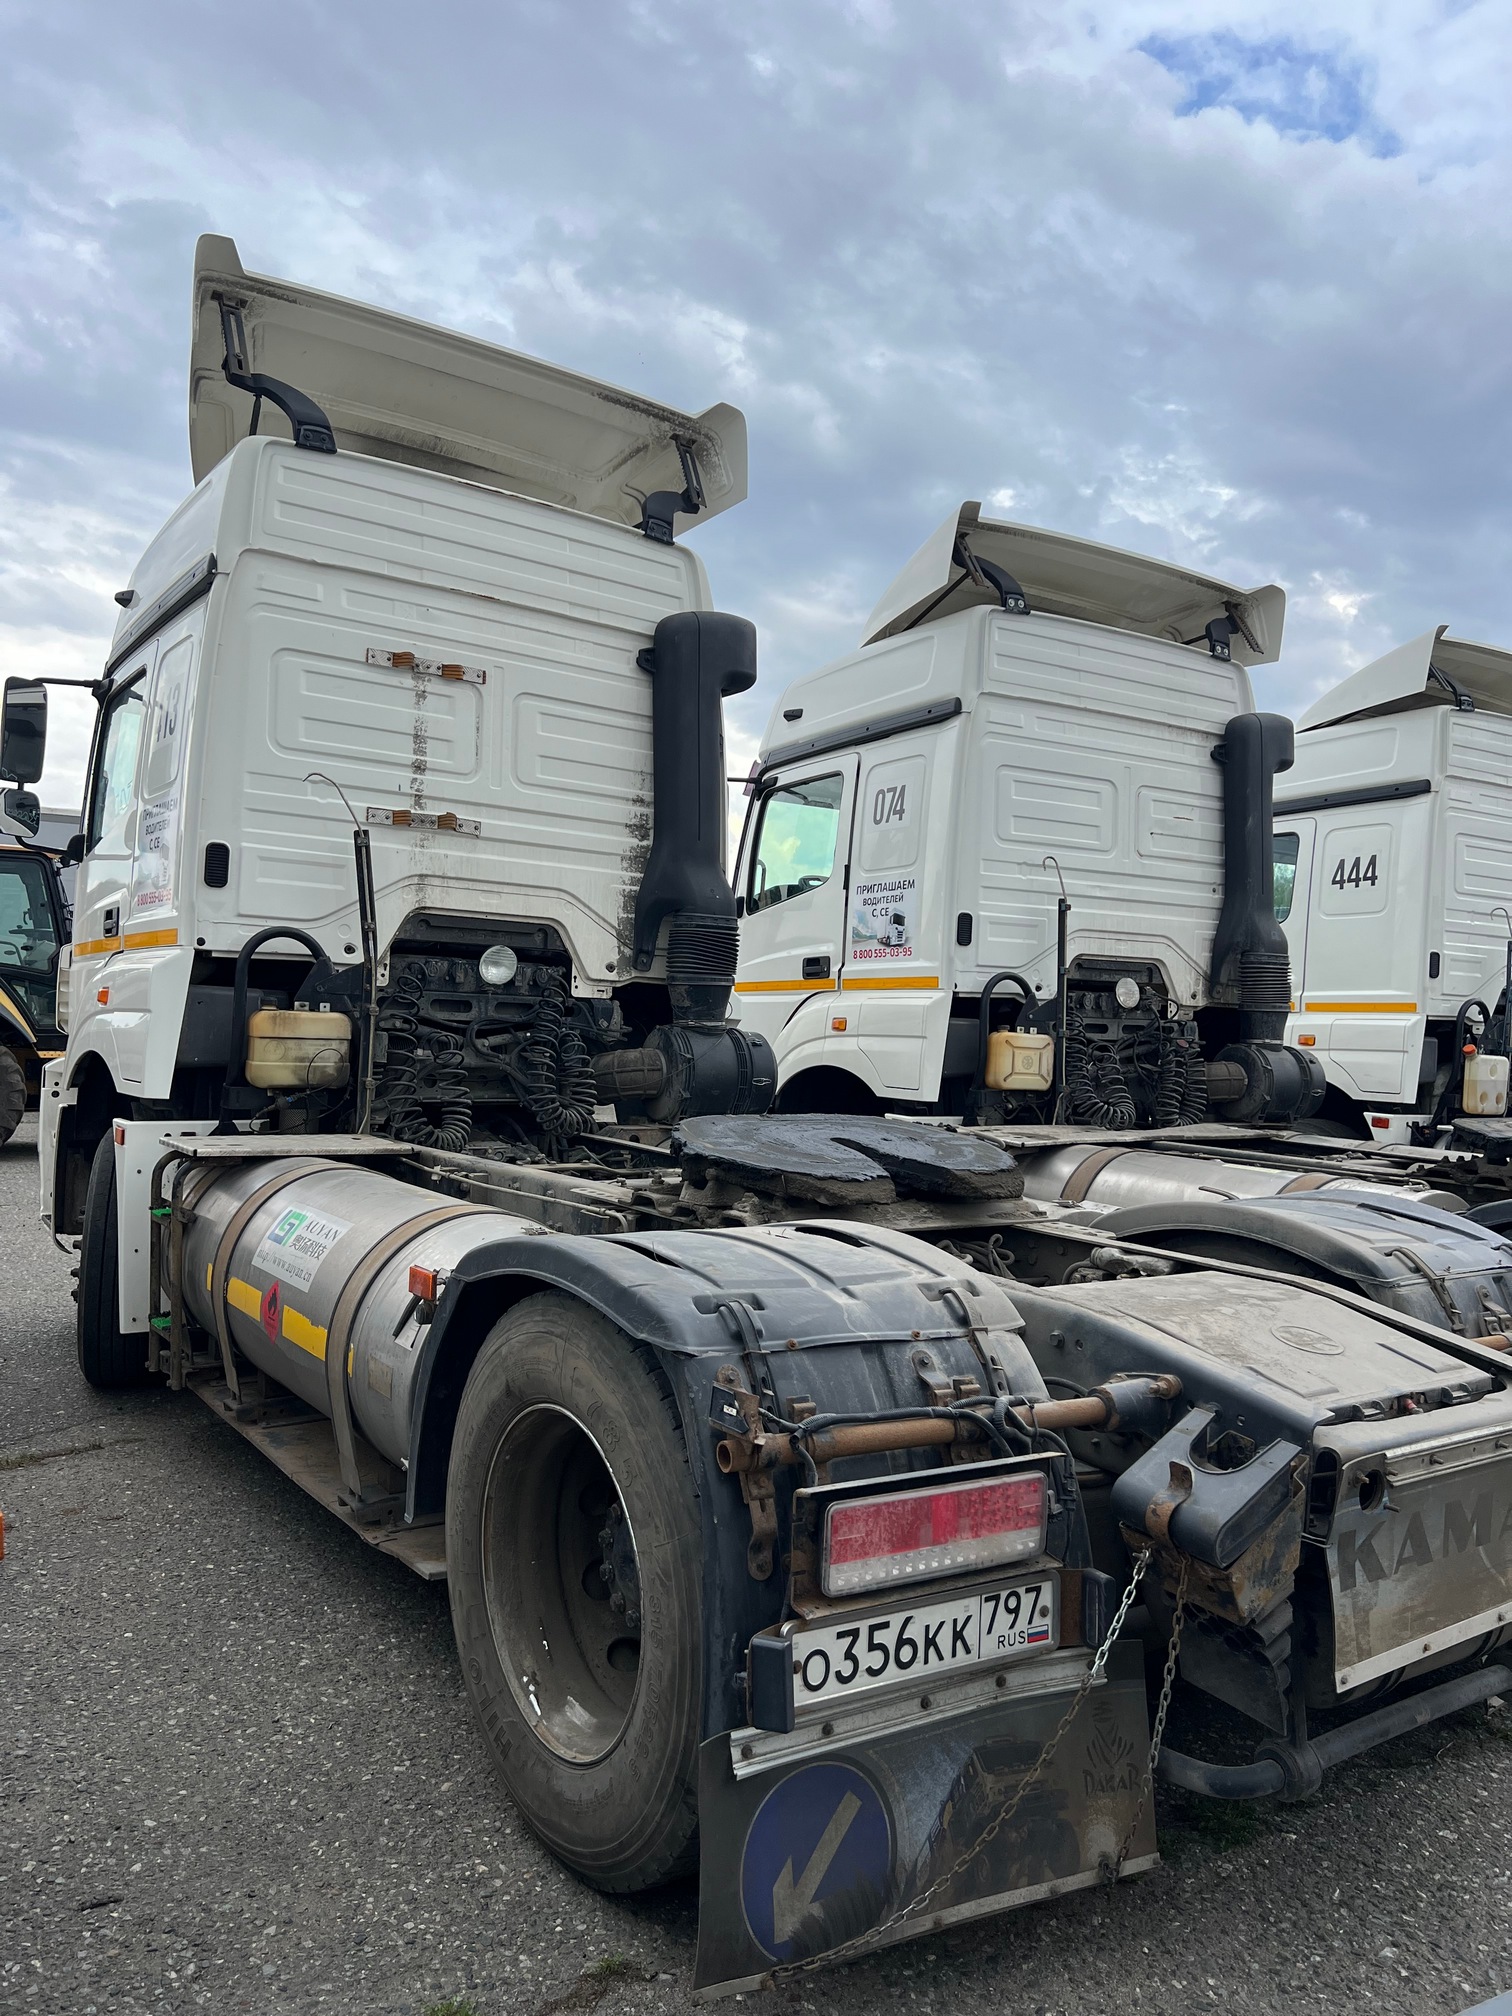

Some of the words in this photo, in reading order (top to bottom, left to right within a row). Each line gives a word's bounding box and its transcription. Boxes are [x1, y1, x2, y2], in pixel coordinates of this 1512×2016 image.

[873, 784, 907, 826] 074
[1331, 854, 1378, 890] 444
[856, 879, 915, 895] ПРИГЛАШАЕМ
[863, 892, 904, 906] ВОДИТЕЛЕЙ
[853, 950, 858, 960] 8
[858, 949, 873, 959] 800
[873, 946, 912, 958] 555-03-95
[302, 1220, 342, 1242] AUYAN
[983, 1584, 1043, 1636] 797
[997, 1630, 1026, 1650] RUS
[1082, 1762, 1141, 1797] DAKAR
